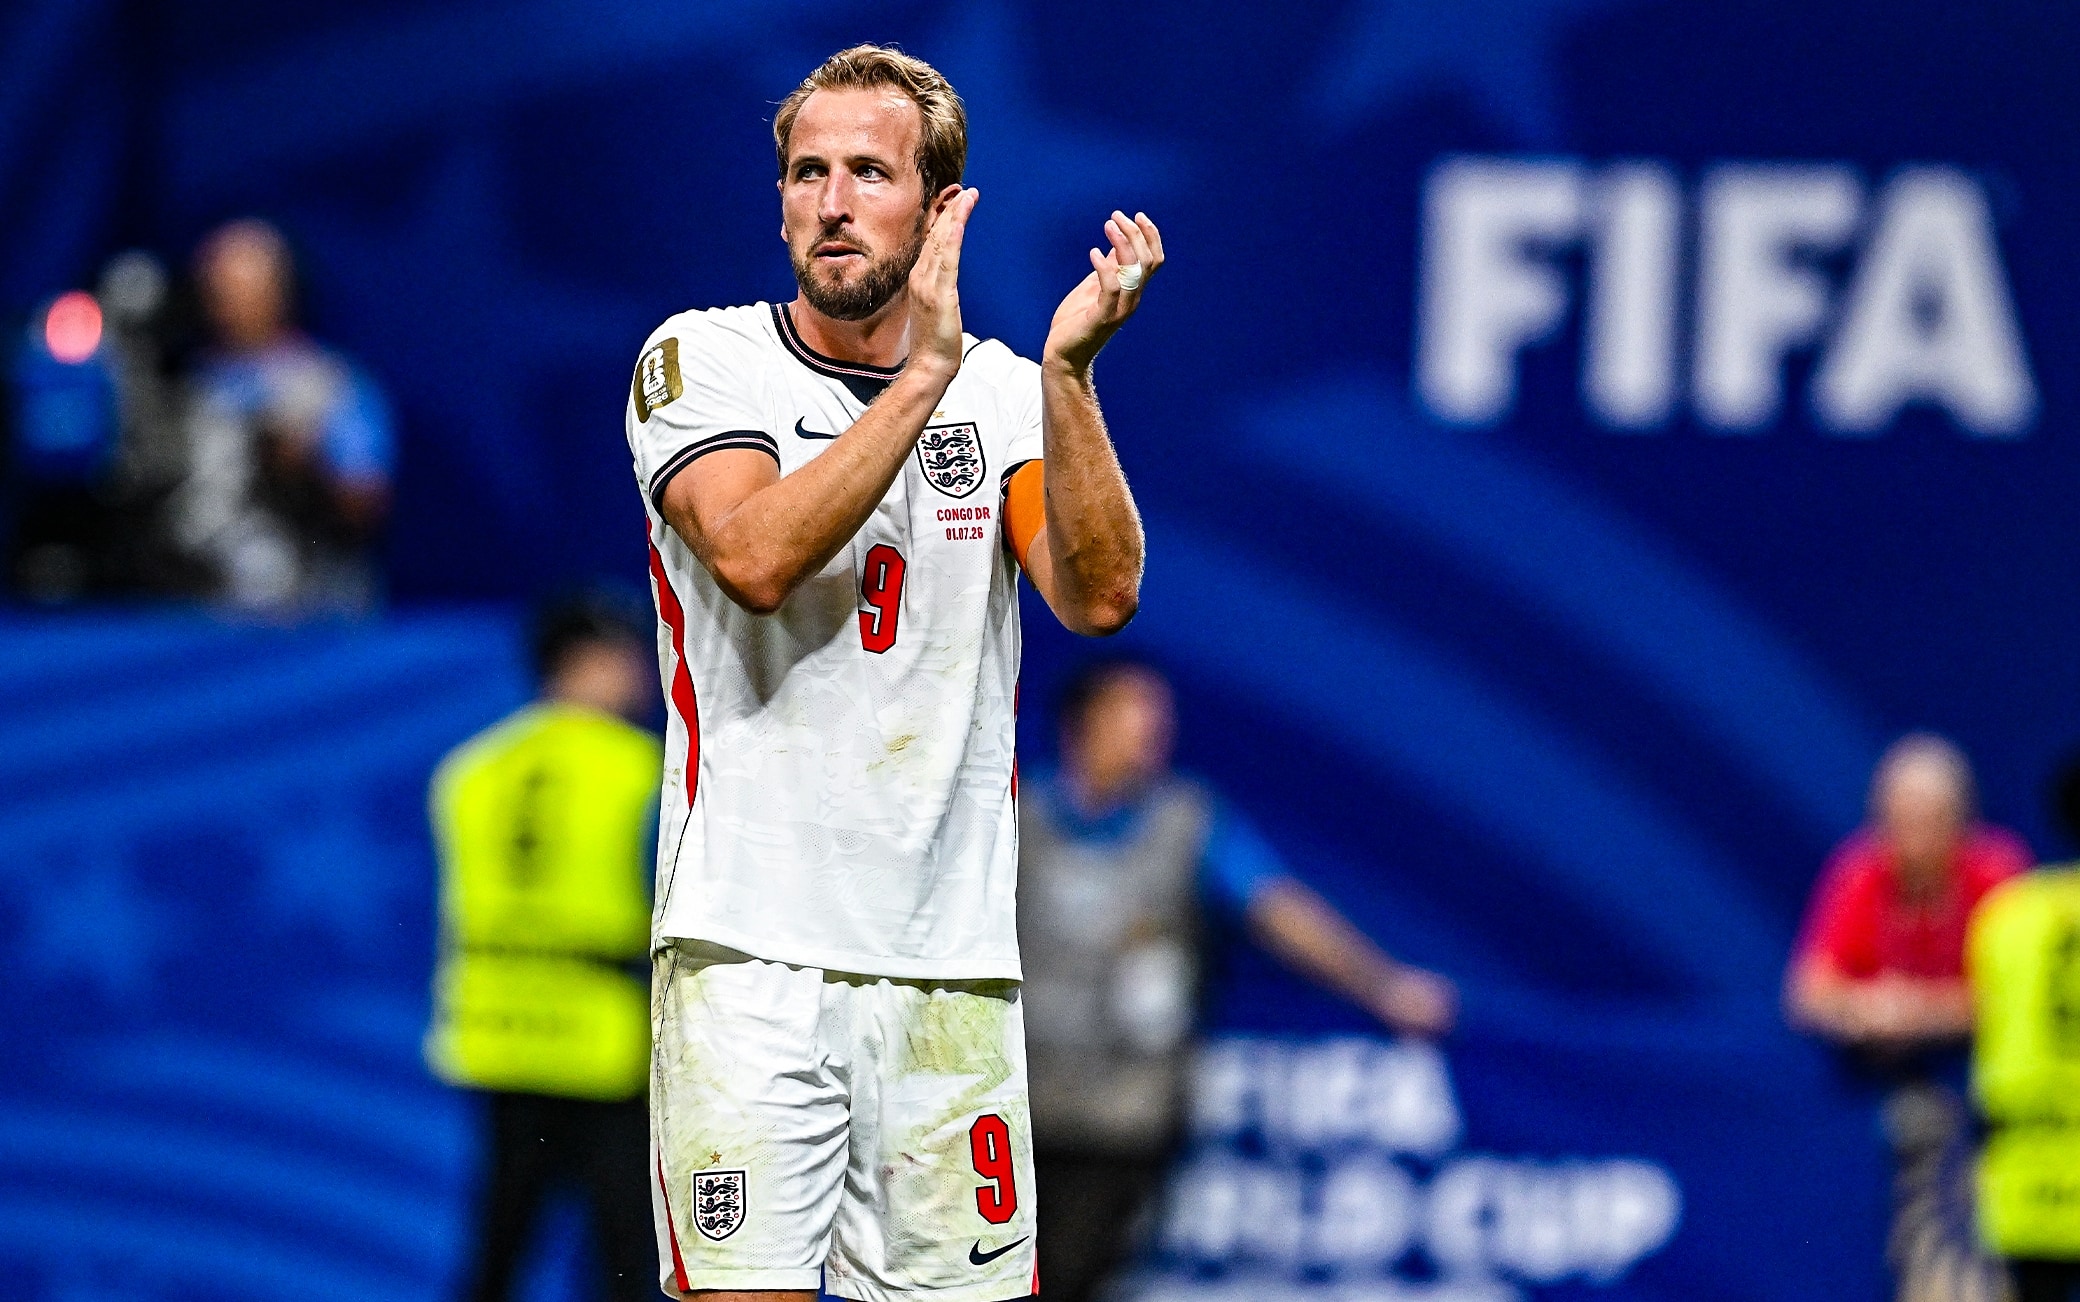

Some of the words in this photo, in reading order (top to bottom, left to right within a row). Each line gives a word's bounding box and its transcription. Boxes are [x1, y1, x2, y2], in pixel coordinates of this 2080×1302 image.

[1418, 156, 2036, 432] FIFA
[936, 508, 973, 521] CONGO
[975, 506, 991, 520] DR
[945, 526, 984, 541] 01.07.26
[858, 543, 906, 655] 9
[969, 1113, 1018, 1225] 9
